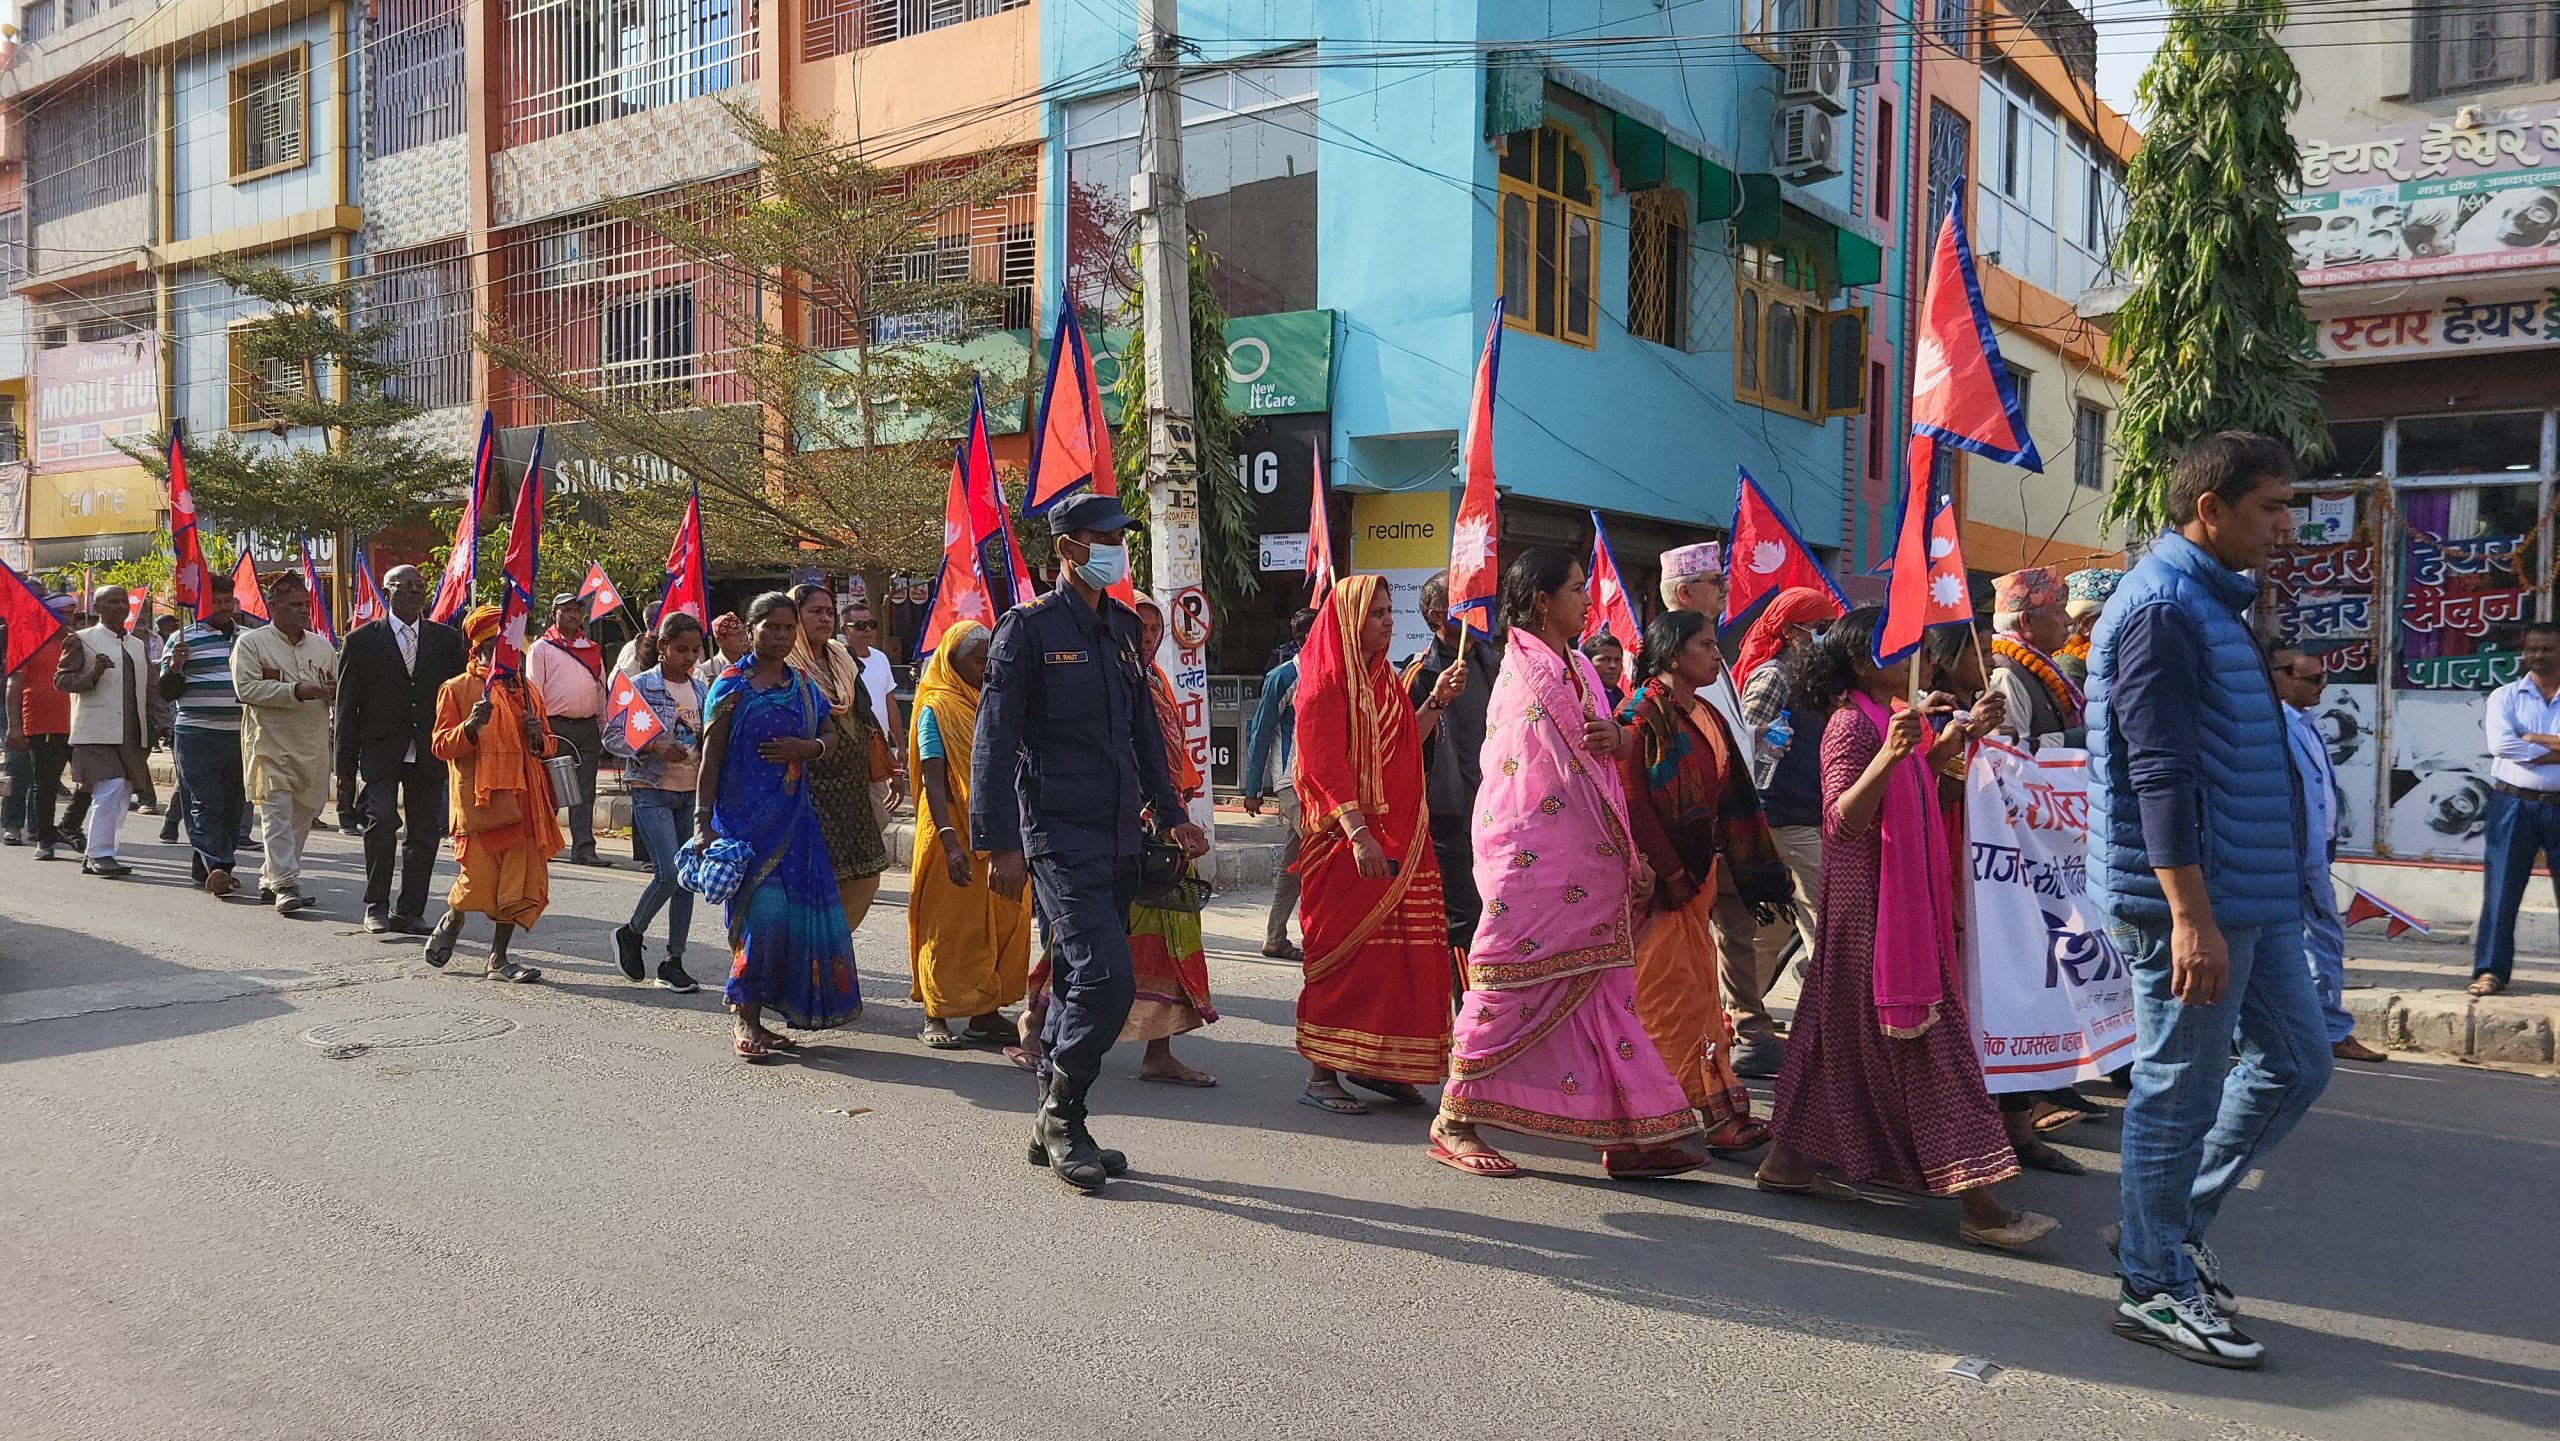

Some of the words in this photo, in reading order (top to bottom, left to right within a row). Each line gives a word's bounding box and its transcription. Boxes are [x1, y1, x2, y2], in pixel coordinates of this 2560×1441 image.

[2331, 308, 2433, 351] स्टार
[2441, 297, 2541, 345] हेयर
[41, 376, 116, 421] MOBILE
[1265, 394, 1297, 409] Care
[1368, 520, 1435, 540] realme
[83, 545, 124, 562] SAMSUNG
[2267, 545, 2375, 600] स्टार
